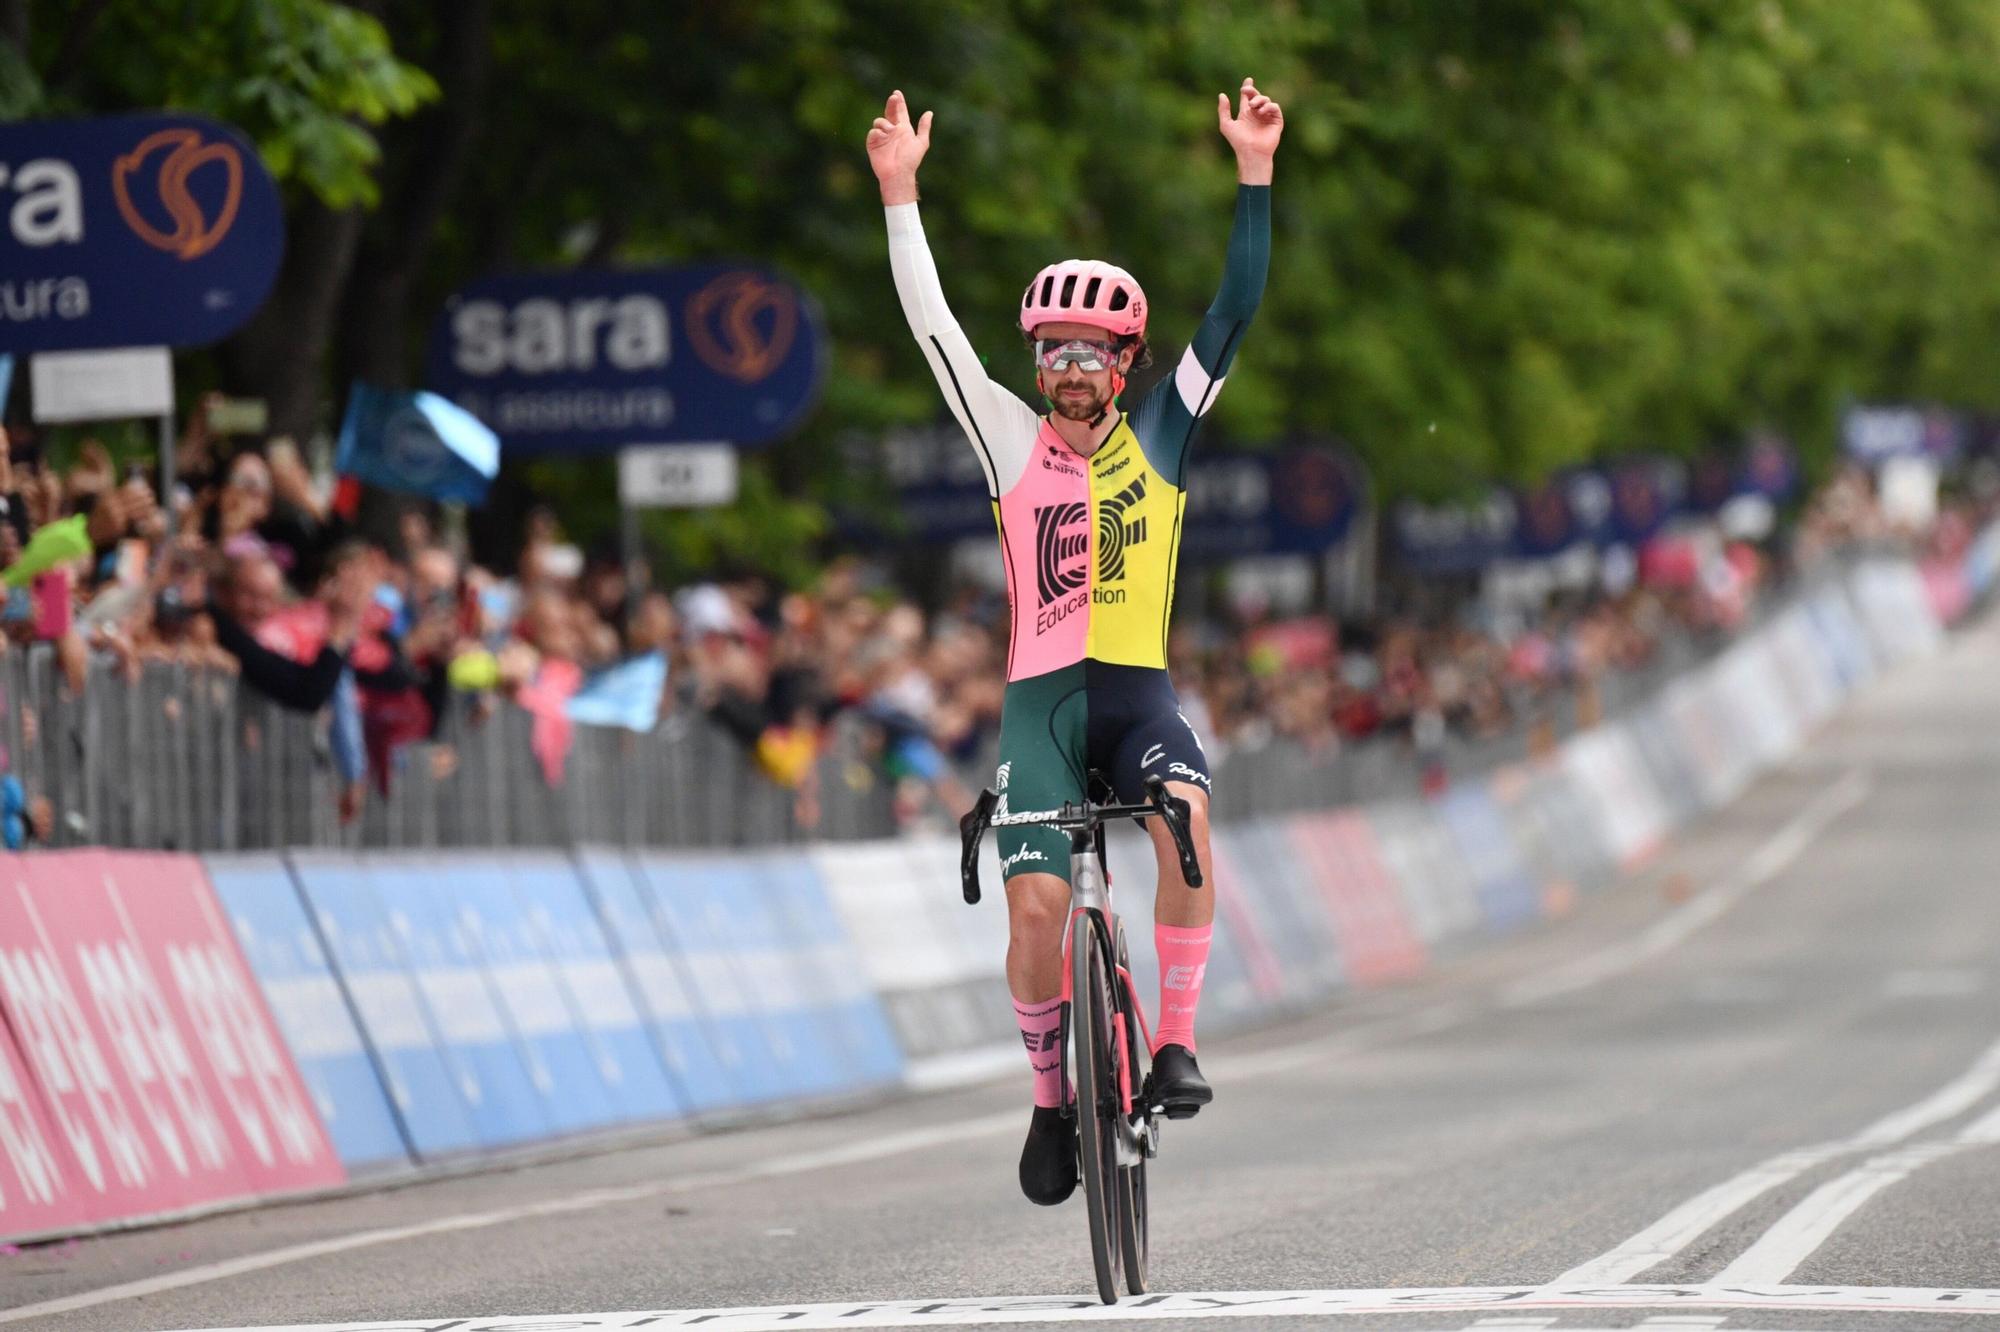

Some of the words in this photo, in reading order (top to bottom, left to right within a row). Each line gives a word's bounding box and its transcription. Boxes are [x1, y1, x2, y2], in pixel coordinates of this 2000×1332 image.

[0, 157, 83, 247] a
[0, 276, 91, 321] ura
[1132, 302, 1142, 318] EF
[452, 294, 671, 376] sara
[1053, 463, 1085, 478] NIPPO
[1096, 456, 1131, 479] wahoo
[1034, 472, 1148, 609] EF
[1036, 586, 1126, 637] Education
